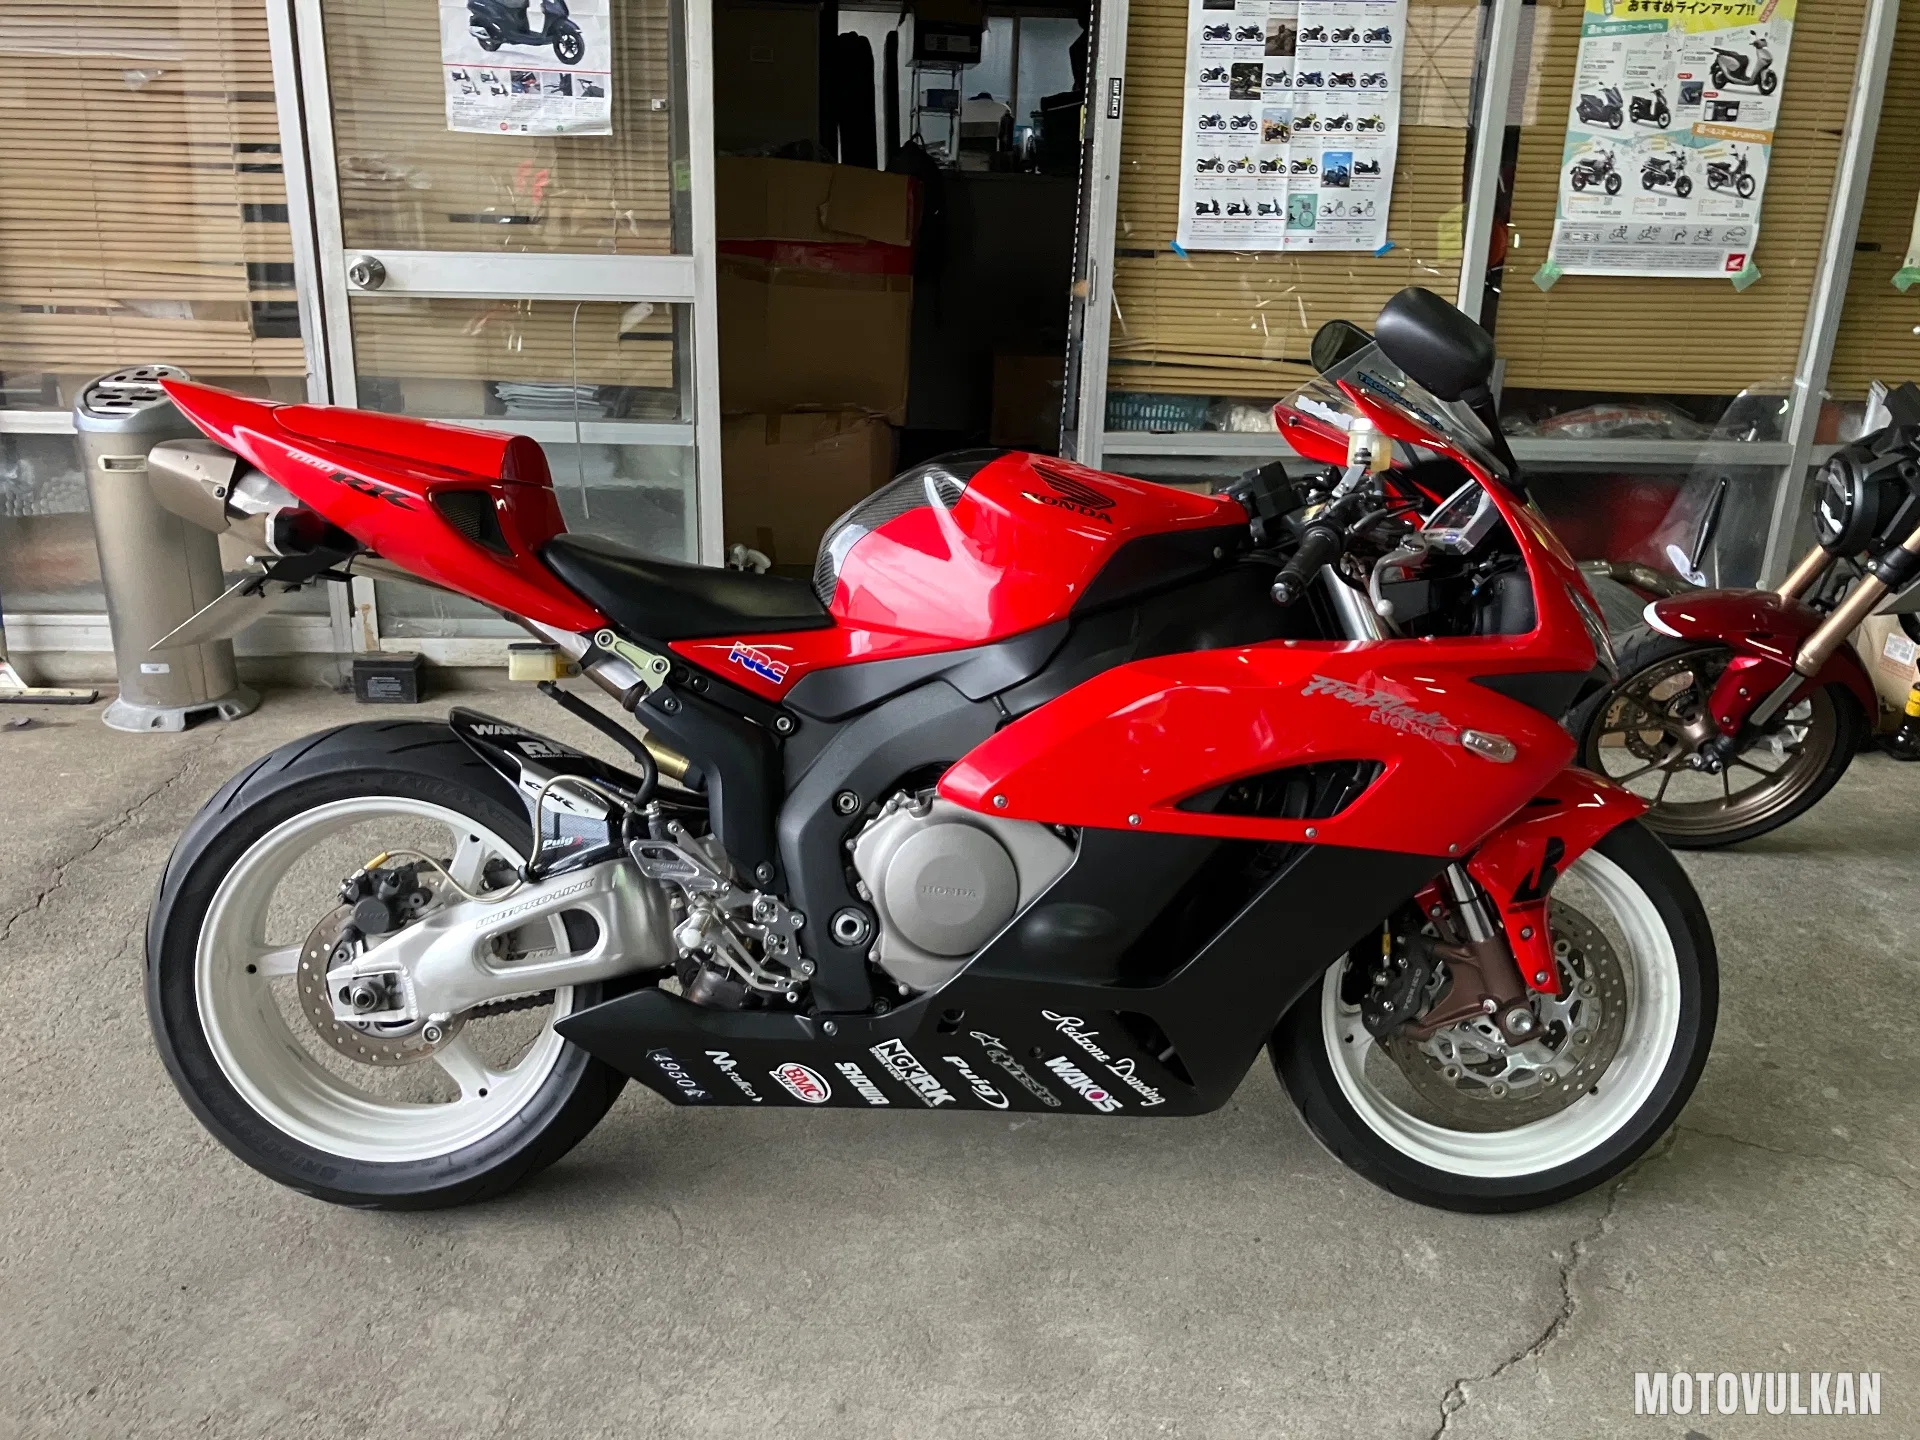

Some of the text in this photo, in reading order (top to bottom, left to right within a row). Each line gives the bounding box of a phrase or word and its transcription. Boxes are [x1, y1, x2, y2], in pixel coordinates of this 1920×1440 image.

[728, 640, 789, 685] HRC
[1041, 1010, 1110, 1063] Redzone
[783, 1066, 824, 1101] BMC
[834, 1062, 890, 1105] SHOWA
[878, 1041, 927, 1078] NGK
[912, 1074, 957, 1107] RK
[942, 1055, 999, 1098] Puig
